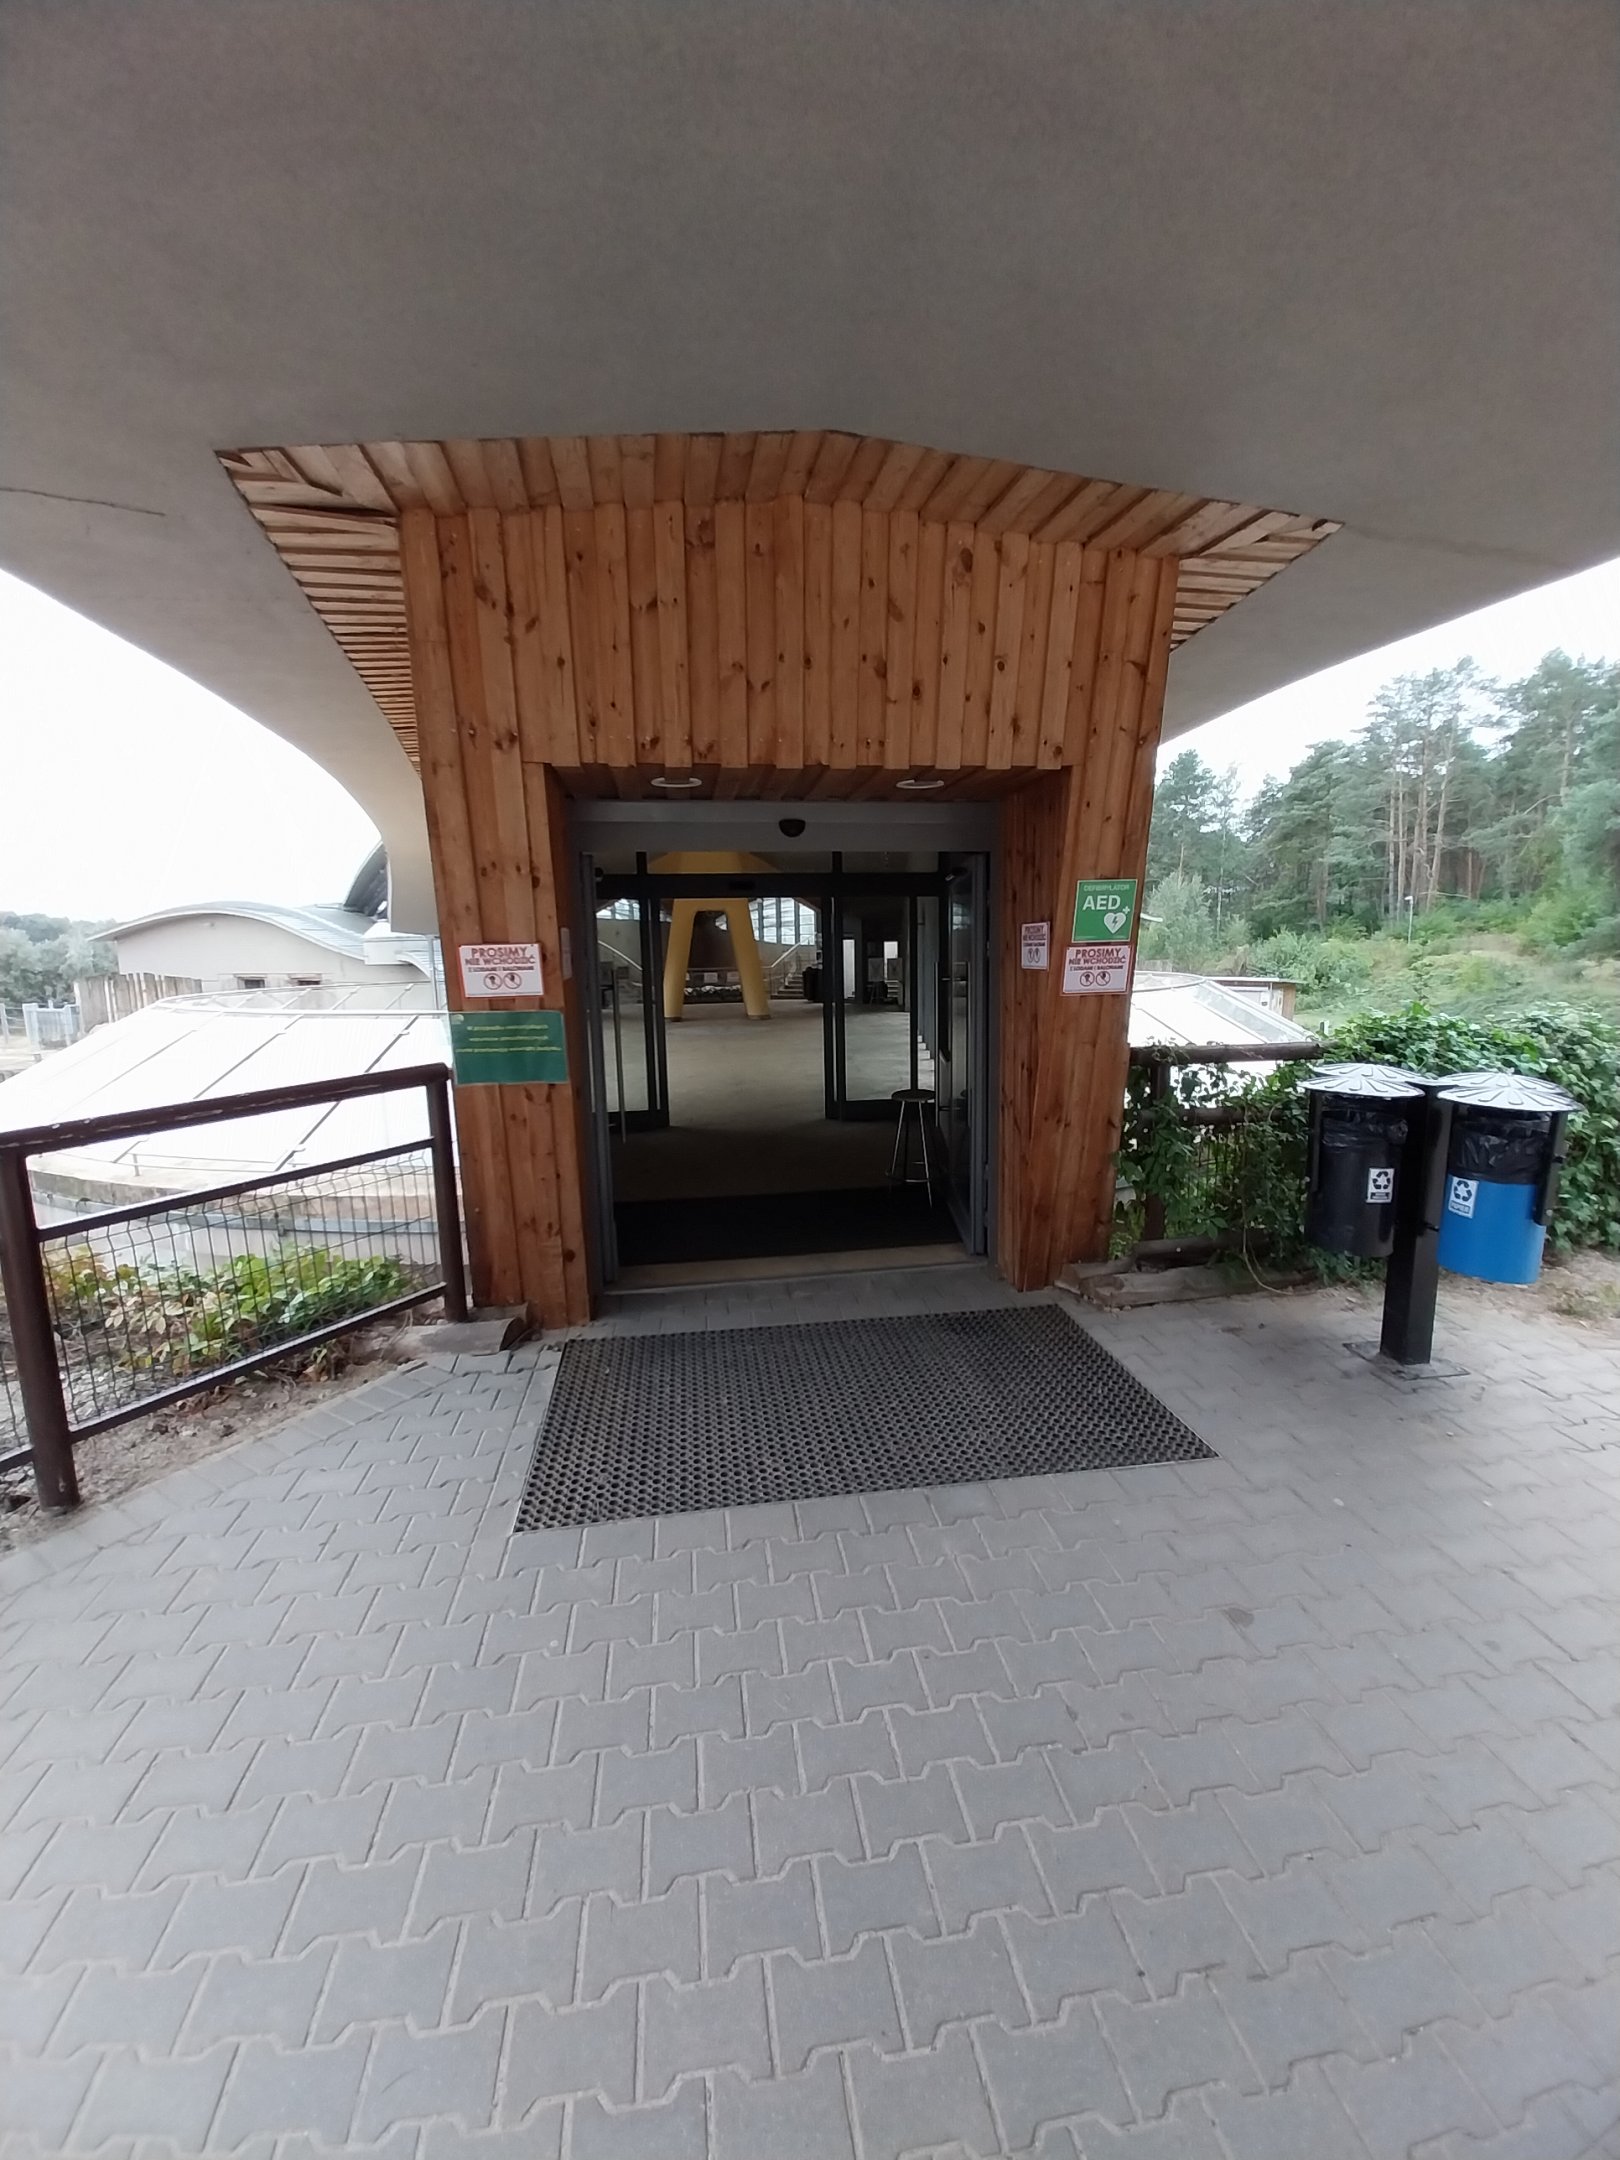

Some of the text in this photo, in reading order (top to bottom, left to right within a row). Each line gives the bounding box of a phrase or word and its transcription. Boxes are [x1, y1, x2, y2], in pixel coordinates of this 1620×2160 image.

[1082, 895, 1121, 911] AED
[471, 947, 527, 958] PROSIMY
[1075, 948, 1122, 958] PROSIMY
[1068, 955, 1127, 966] NIE WCHODZIĆ
